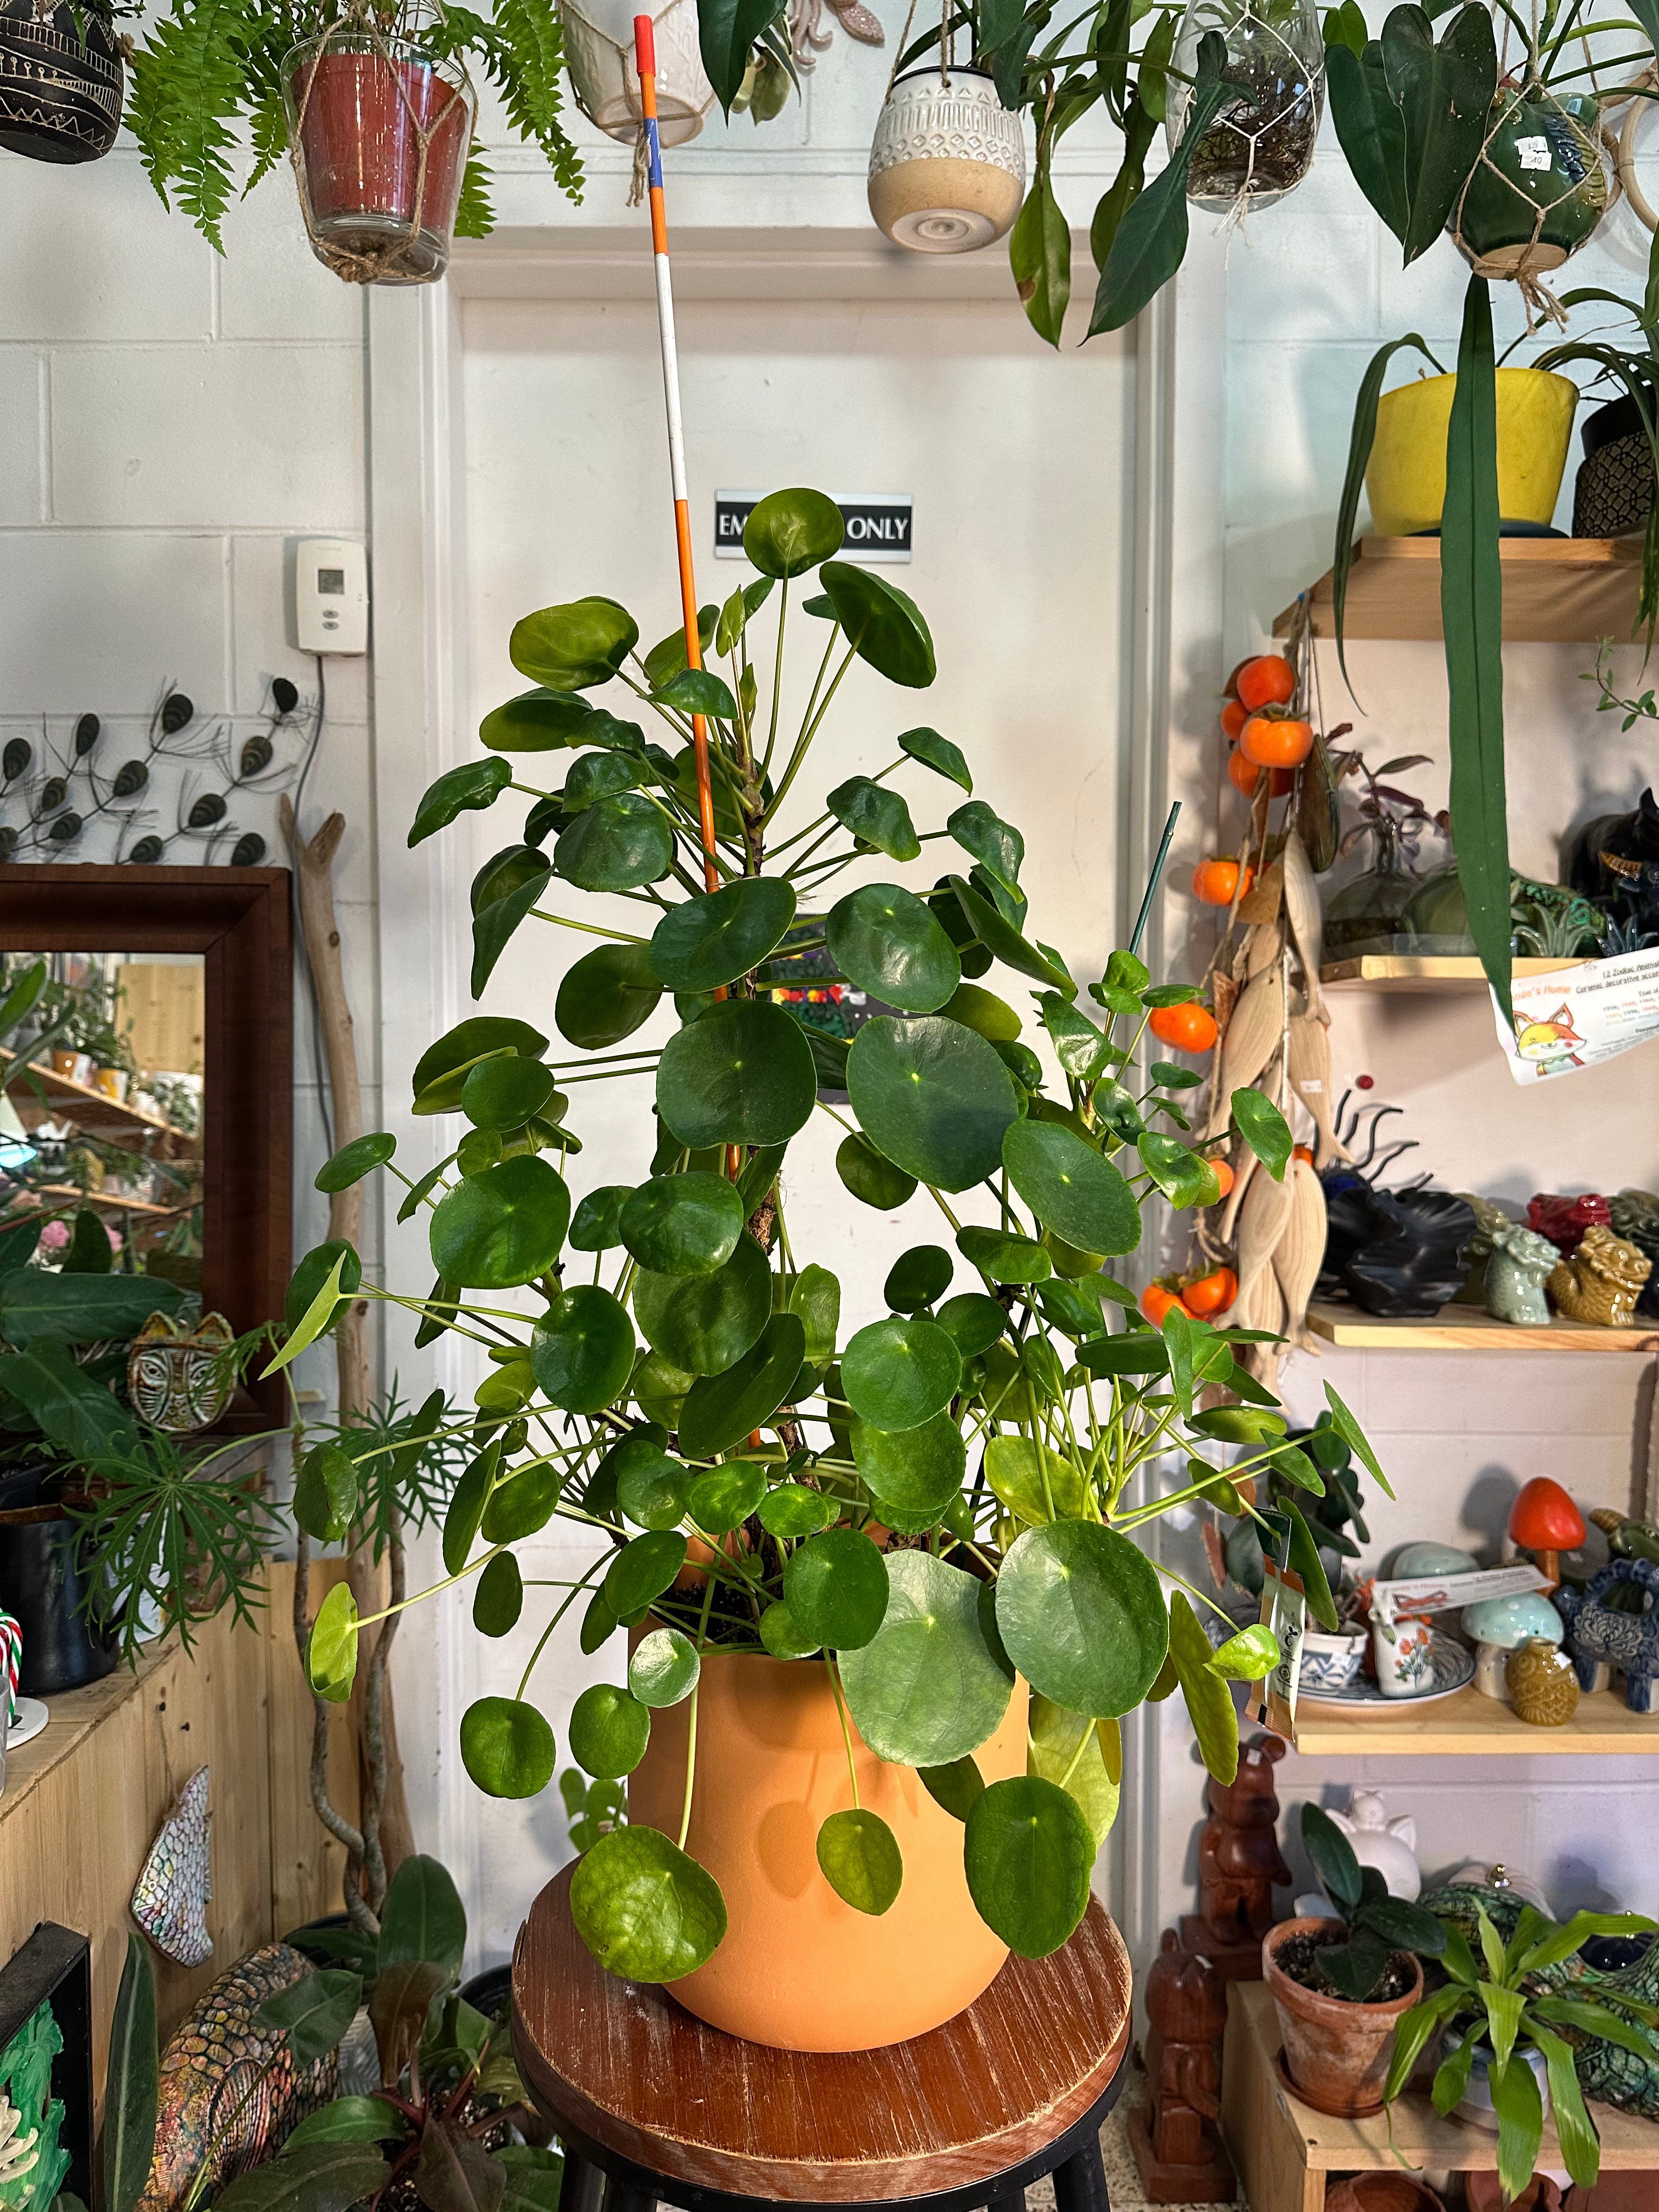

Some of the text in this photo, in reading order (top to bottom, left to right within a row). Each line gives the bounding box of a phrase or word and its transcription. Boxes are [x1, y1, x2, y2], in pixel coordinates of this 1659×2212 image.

[847, 516, 909, 540] ONLY
[1612, 966, 1635, 976] Zodiac
[1544, 984, 1571, 994] Home
[1576, 982, 1603, 994] Ceramic
[1605, 975, 1639, 988] decorative
